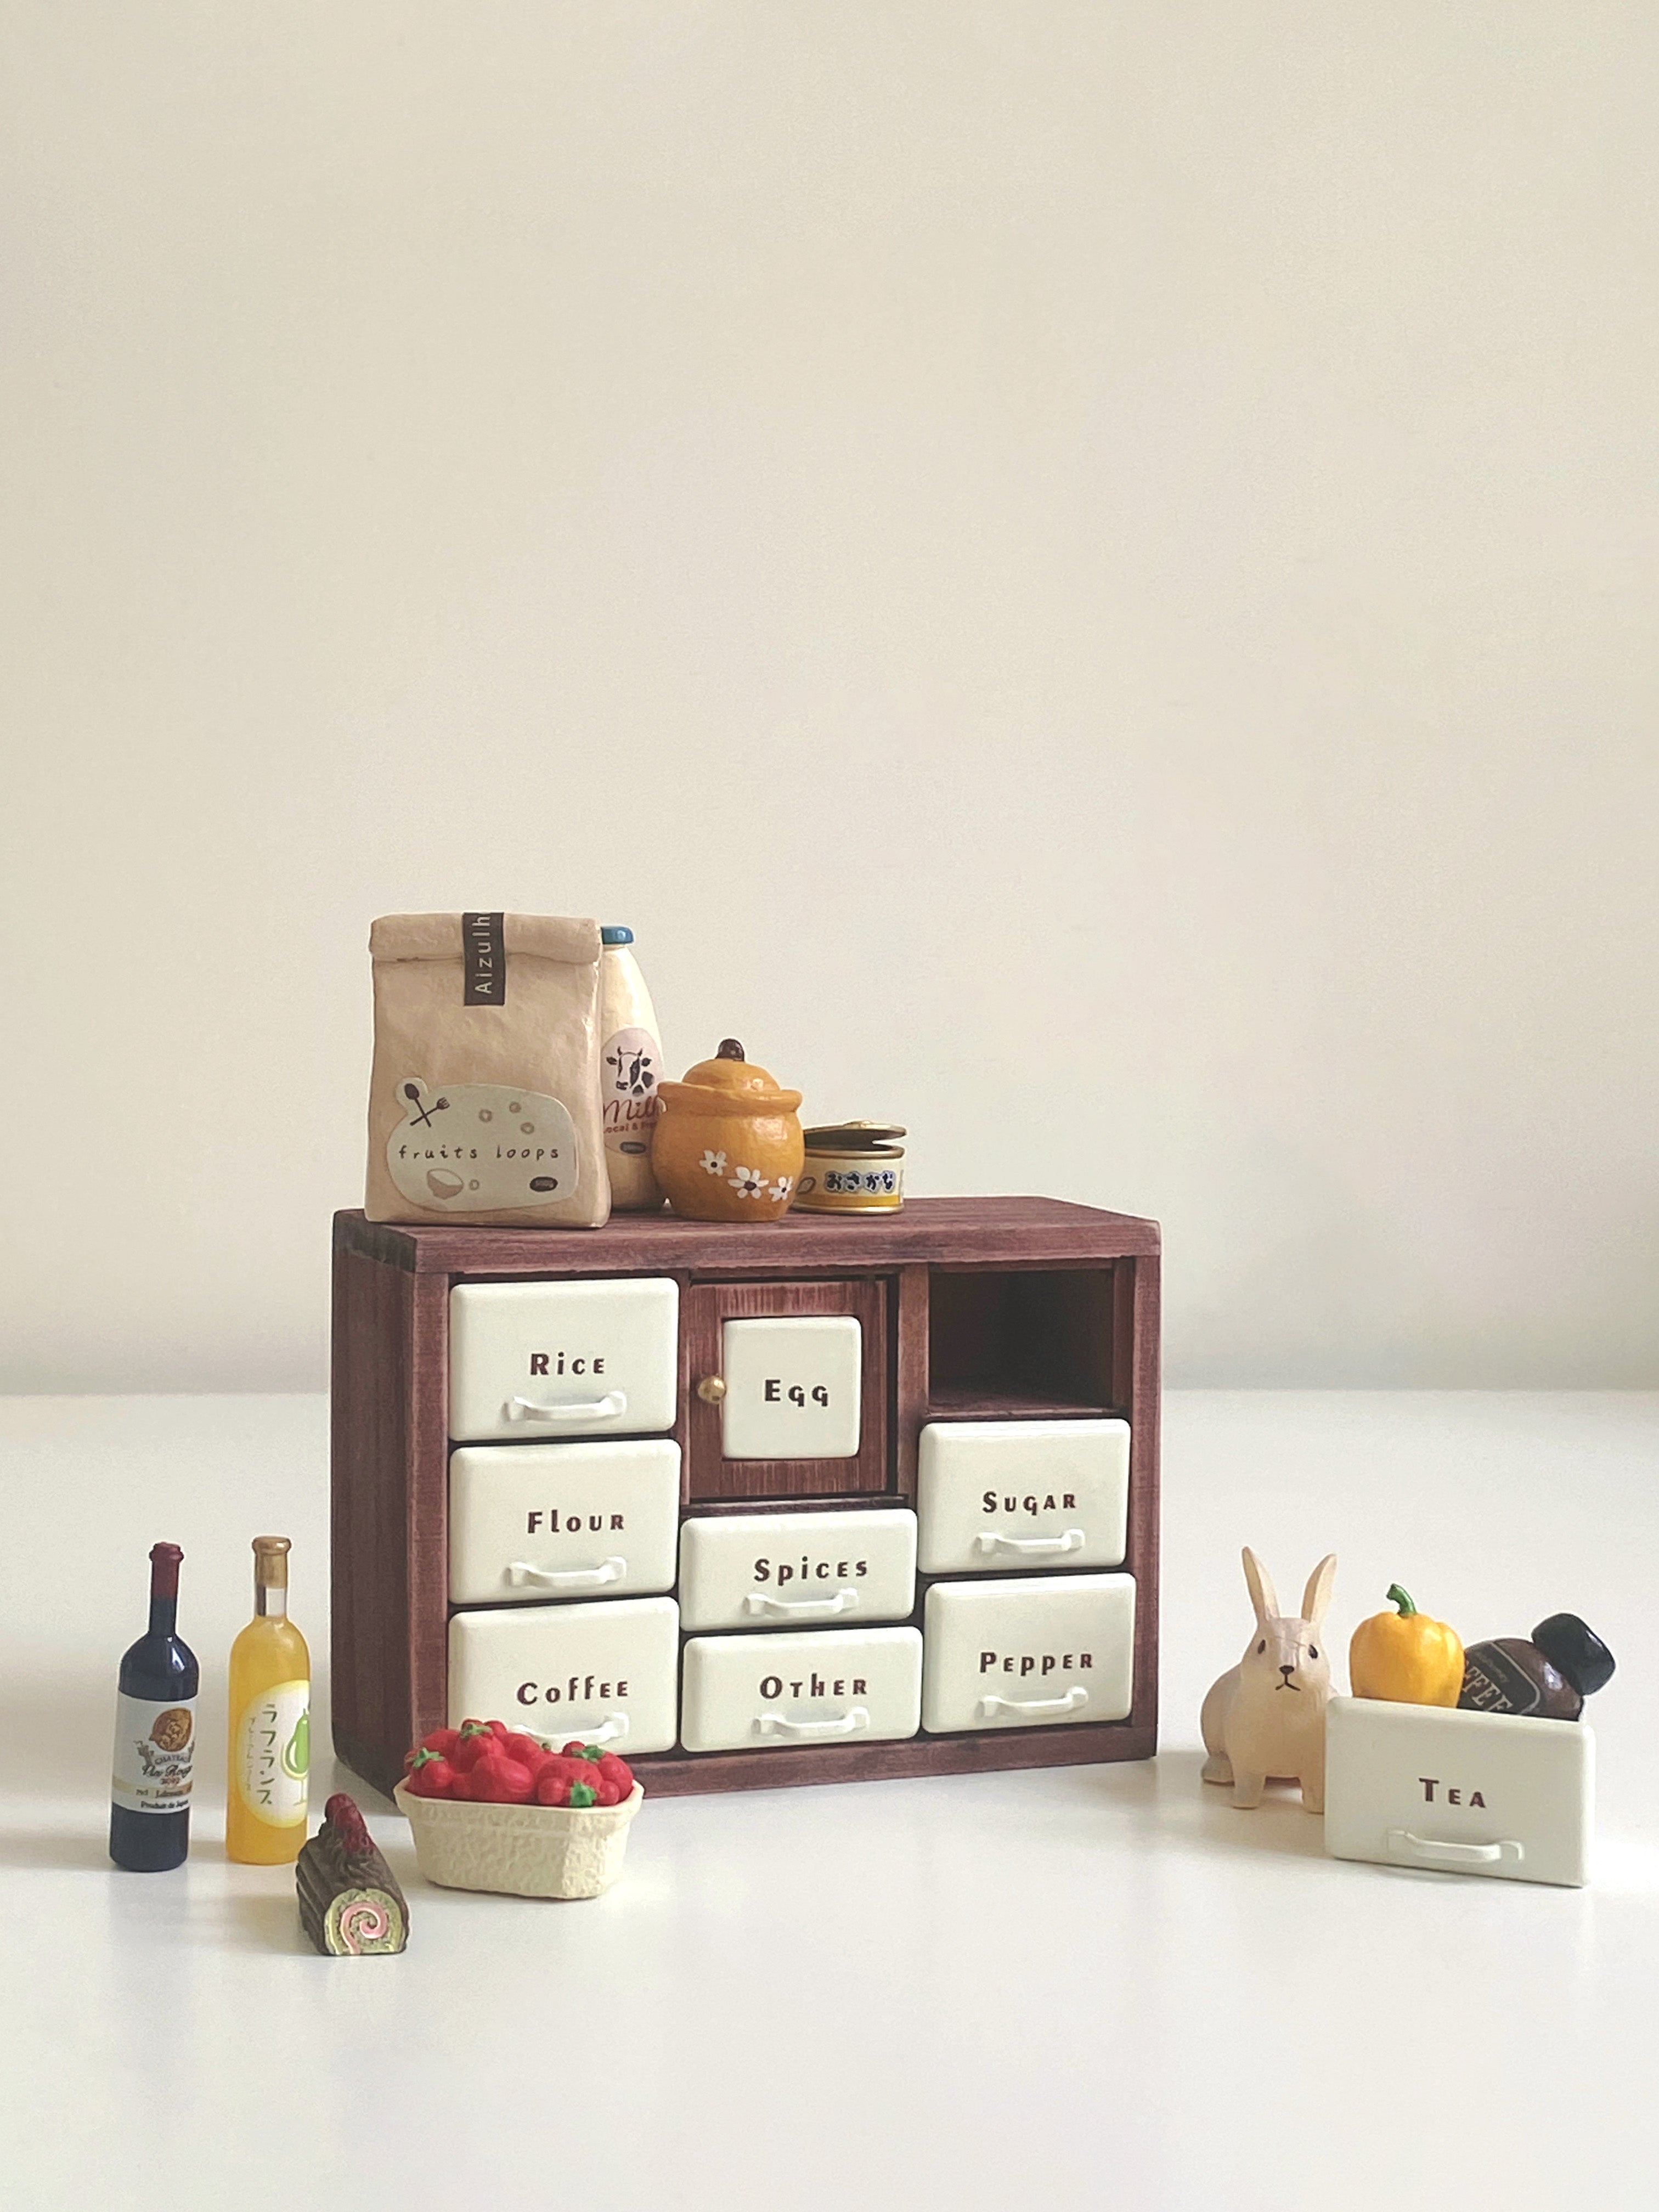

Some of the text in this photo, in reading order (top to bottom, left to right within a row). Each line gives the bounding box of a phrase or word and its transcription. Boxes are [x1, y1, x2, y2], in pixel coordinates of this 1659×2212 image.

[603, 1122, 629, 1133] ocal
[399, 1144, 558, 1161] fruits loops
[530, 1351, 605, 1375] Rice
[764, 1379, 828, 1407] Egg
[754, 1556, 867, 1587] Spices
[1462, 1664, 1513, 1712] FFEE
[256, 1703, 278, 1805] ラフランス
